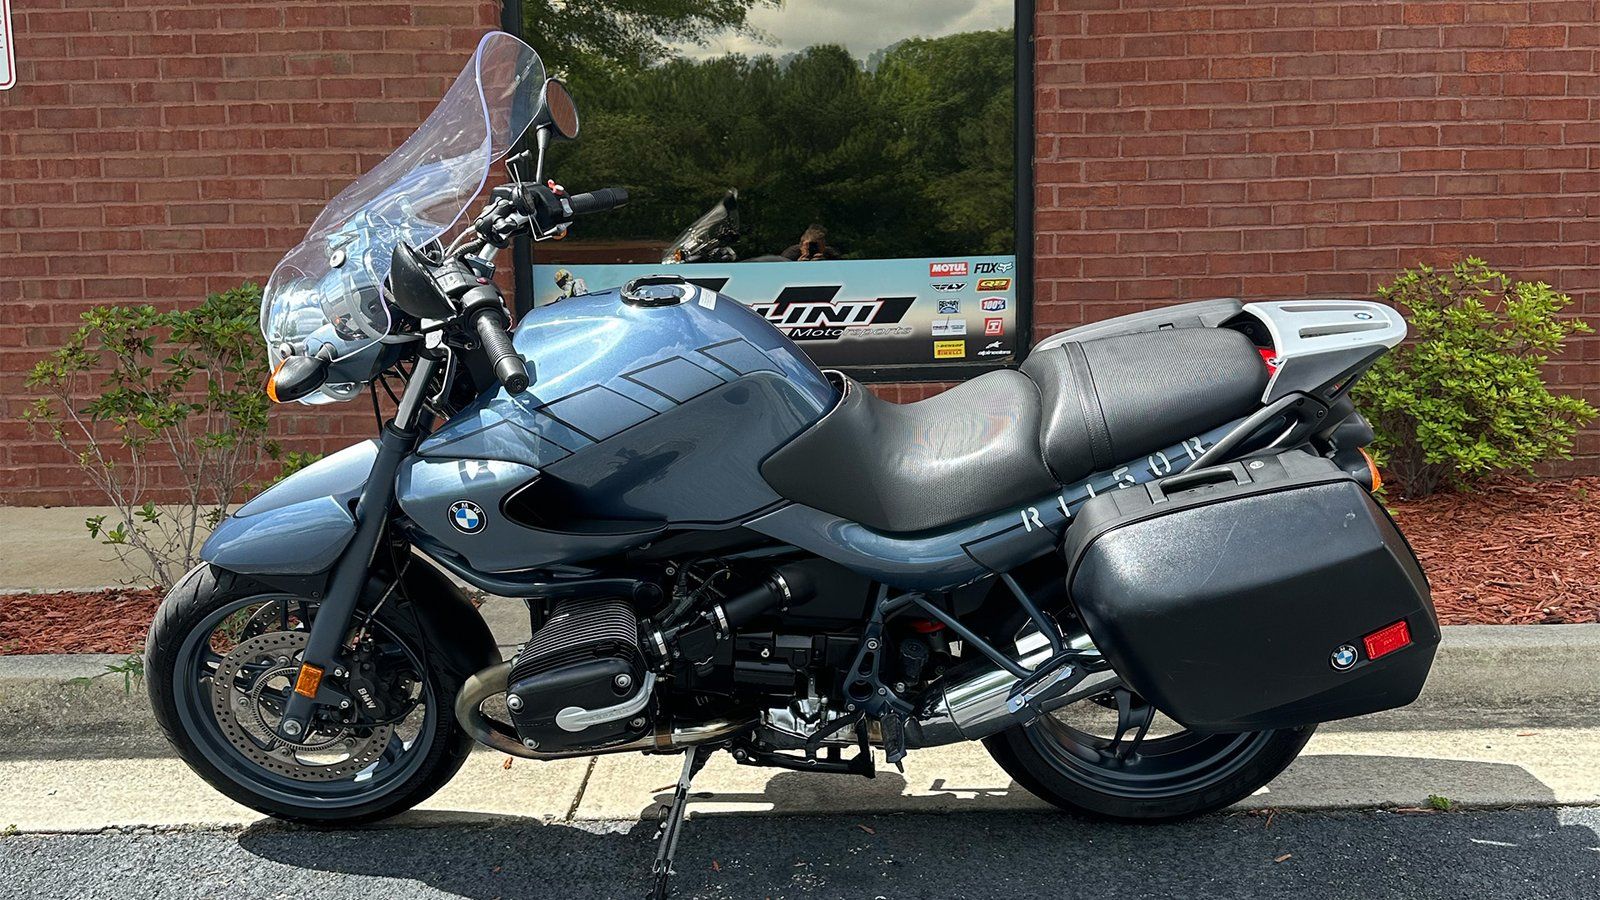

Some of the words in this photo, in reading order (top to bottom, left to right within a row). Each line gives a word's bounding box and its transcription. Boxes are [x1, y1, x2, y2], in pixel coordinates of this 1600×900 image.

[931, 263, 967, 272] MOTUL
[974, 262, 998, 273] FOX
[932, 282, 966, 290] FLY
[983, 300, 1004, 310] 100%
[792, 326, 912, 338] Motorsports
[451, 502, 481, 513] BMW
[358, 688, 376, 708] BMW
